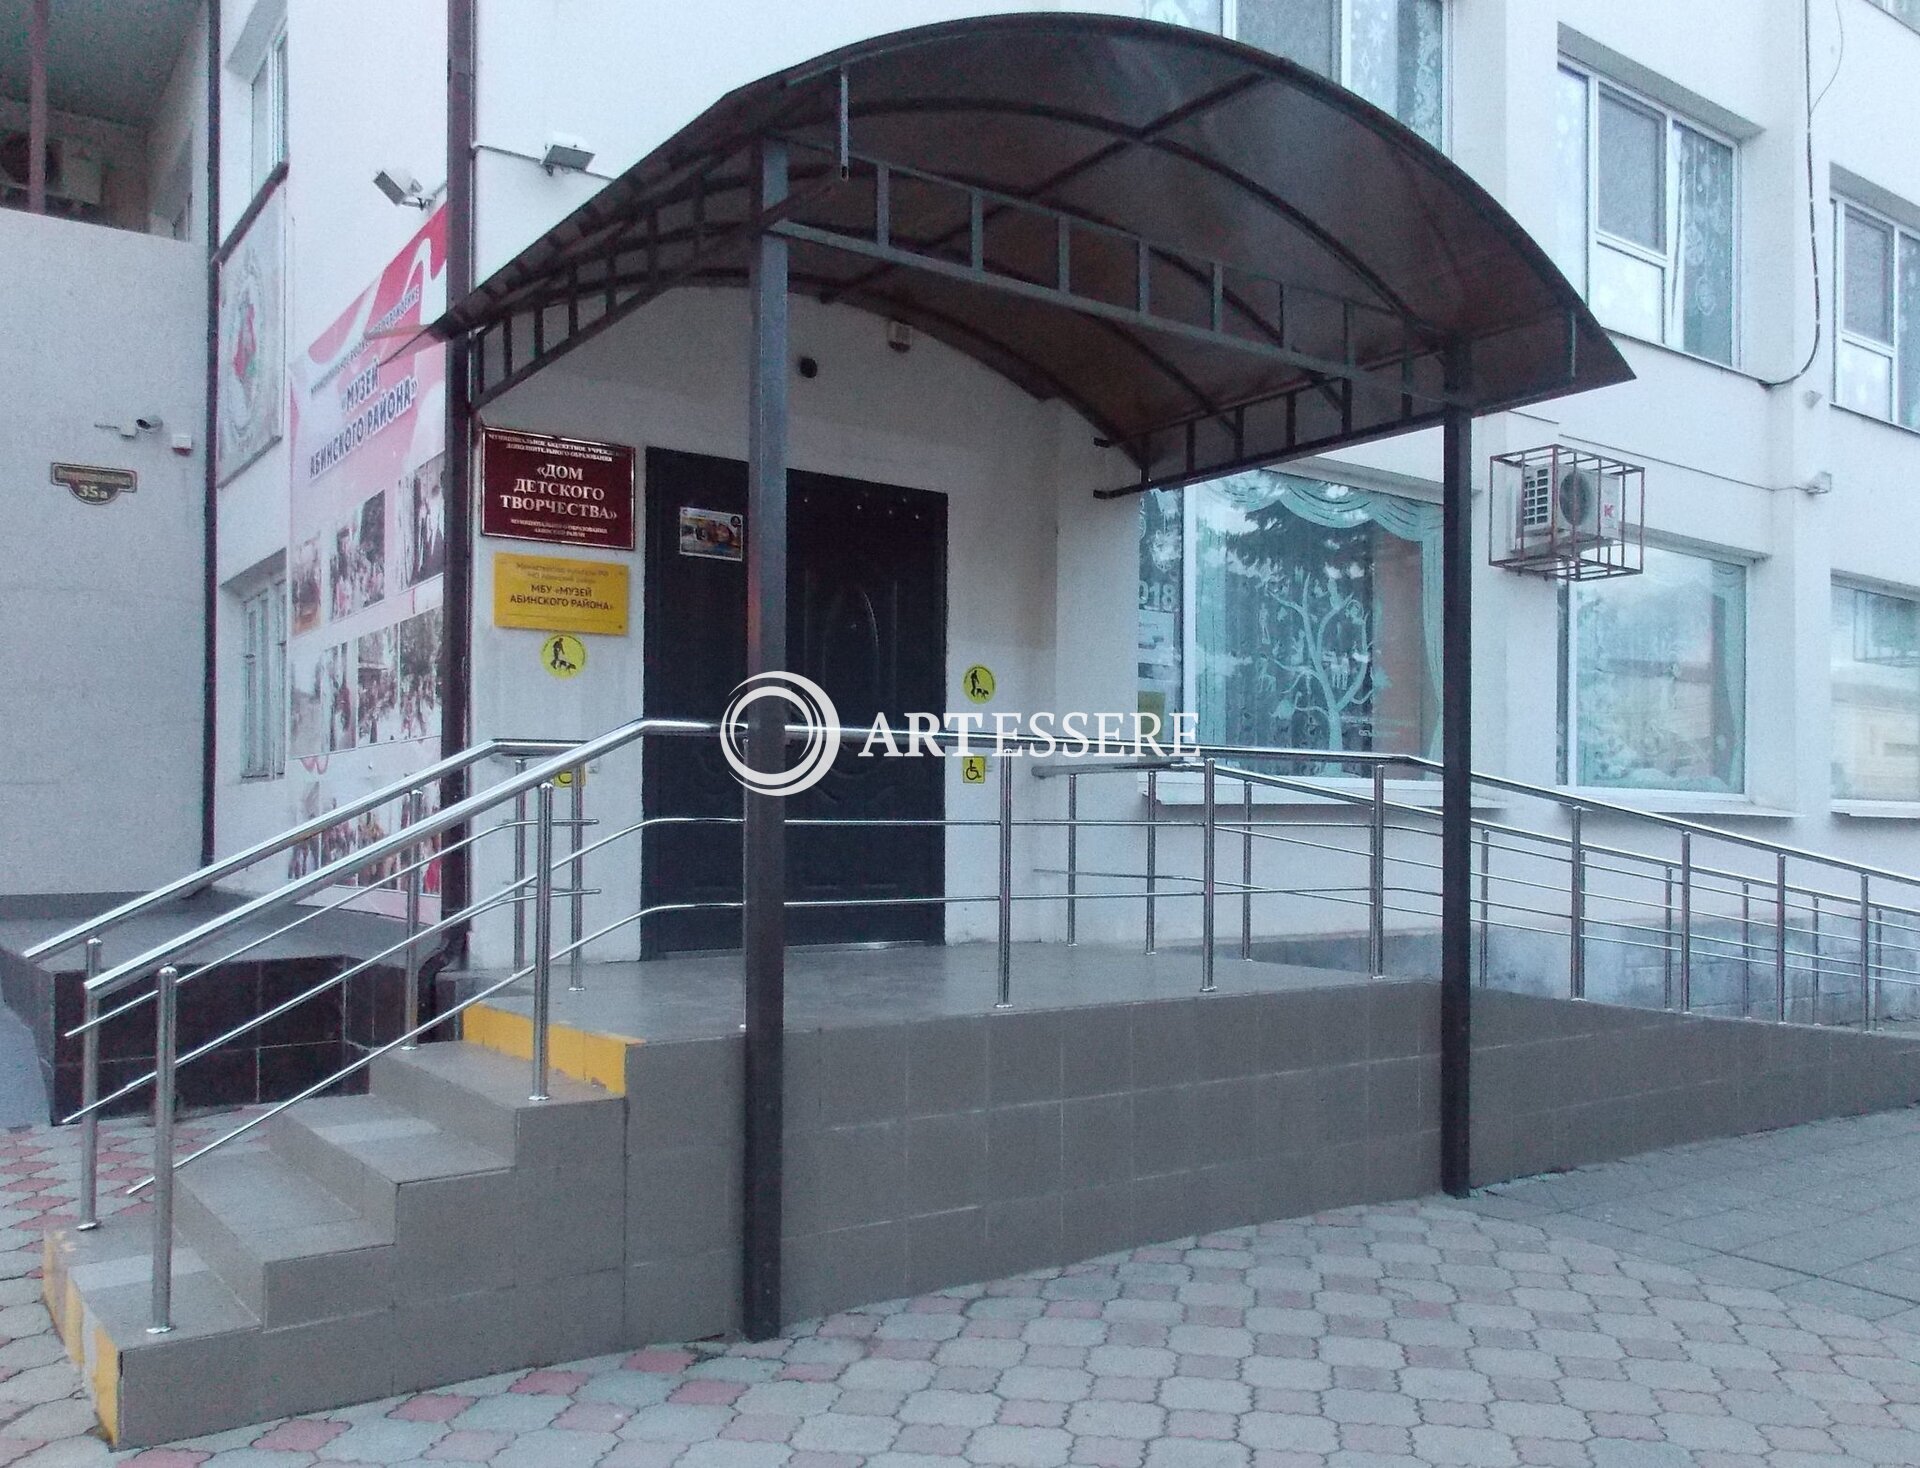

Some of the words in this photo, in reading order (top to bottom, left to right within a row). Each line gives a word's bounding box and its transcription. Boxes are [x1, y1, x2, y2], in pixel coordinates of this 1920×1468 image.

[310, 417, 364, 477] АБИНСКОГО
[367, 378, 418, 435] РАЙОНА»
[536, 463, 584, 481] «ДОМ
[514, 478, 605, 501] ДЕТСКОГО
[500, 494, 617, 519] ТВОРЧЕСТВА»
[531, 584, 551, 593] МБУ
[510, 594, 569, 607] АБИНСКОГО
